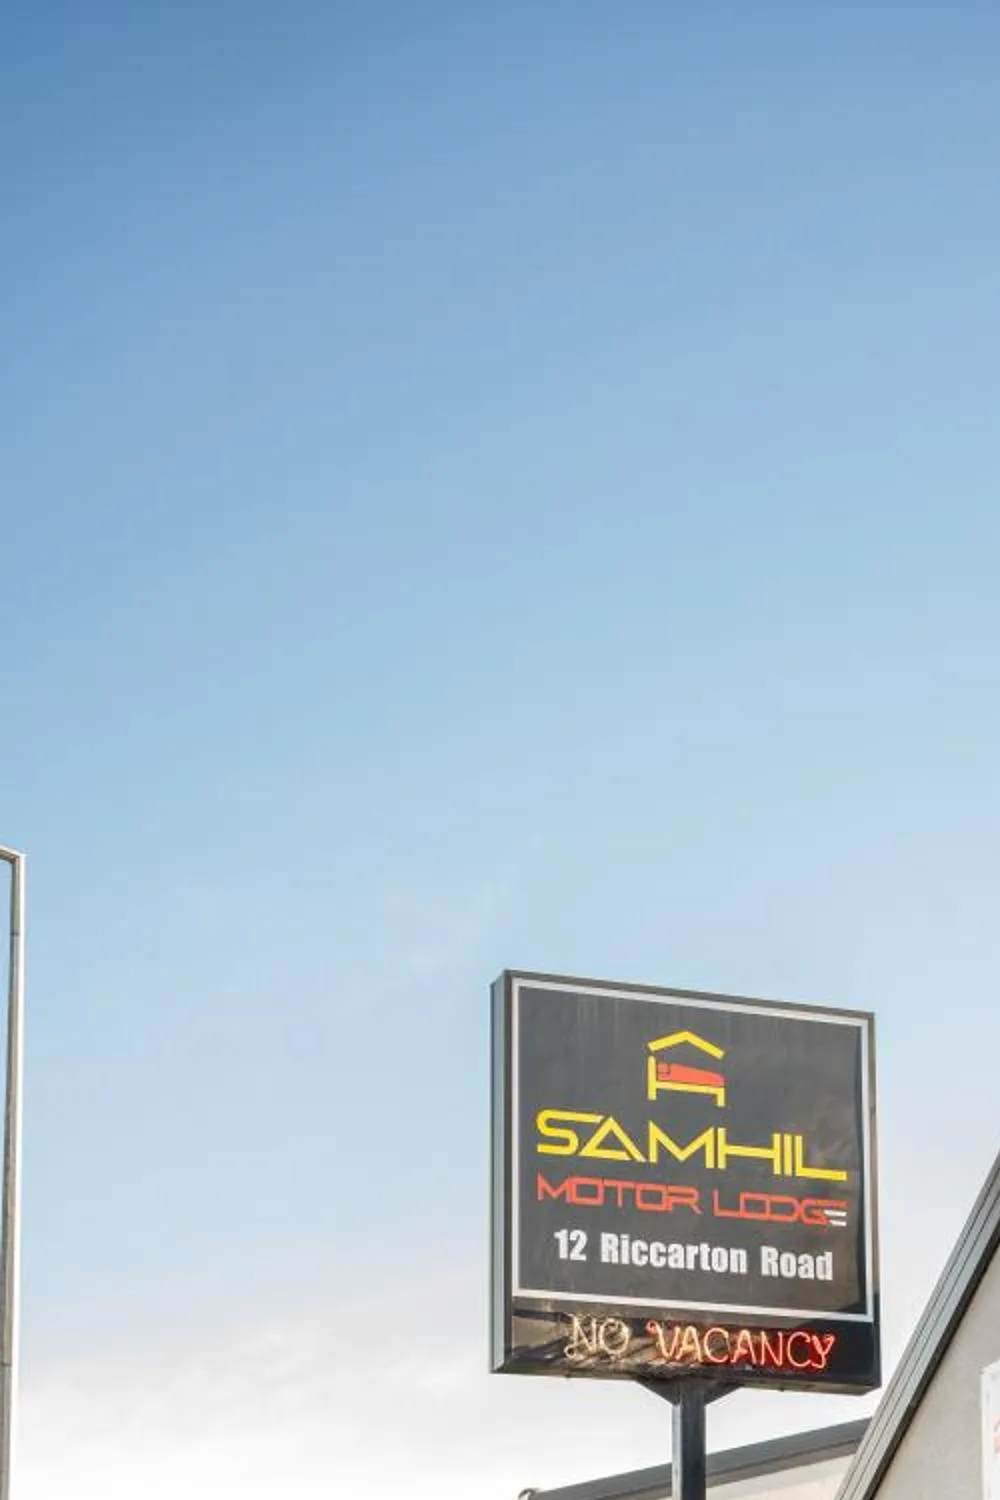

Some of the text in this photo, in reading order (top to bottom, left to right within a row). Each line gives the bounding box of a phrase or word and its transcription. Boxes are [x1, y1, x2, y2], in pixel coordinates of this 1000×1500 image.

[536, 1109, 848, 1181] SAMHIL
[537, 1173, 848, 1228] MOTOR LODGE
[554, 1229, 833, 1281] 12 Riccarton Road
[564, 1312, 836, 1370] NO VACANCY
